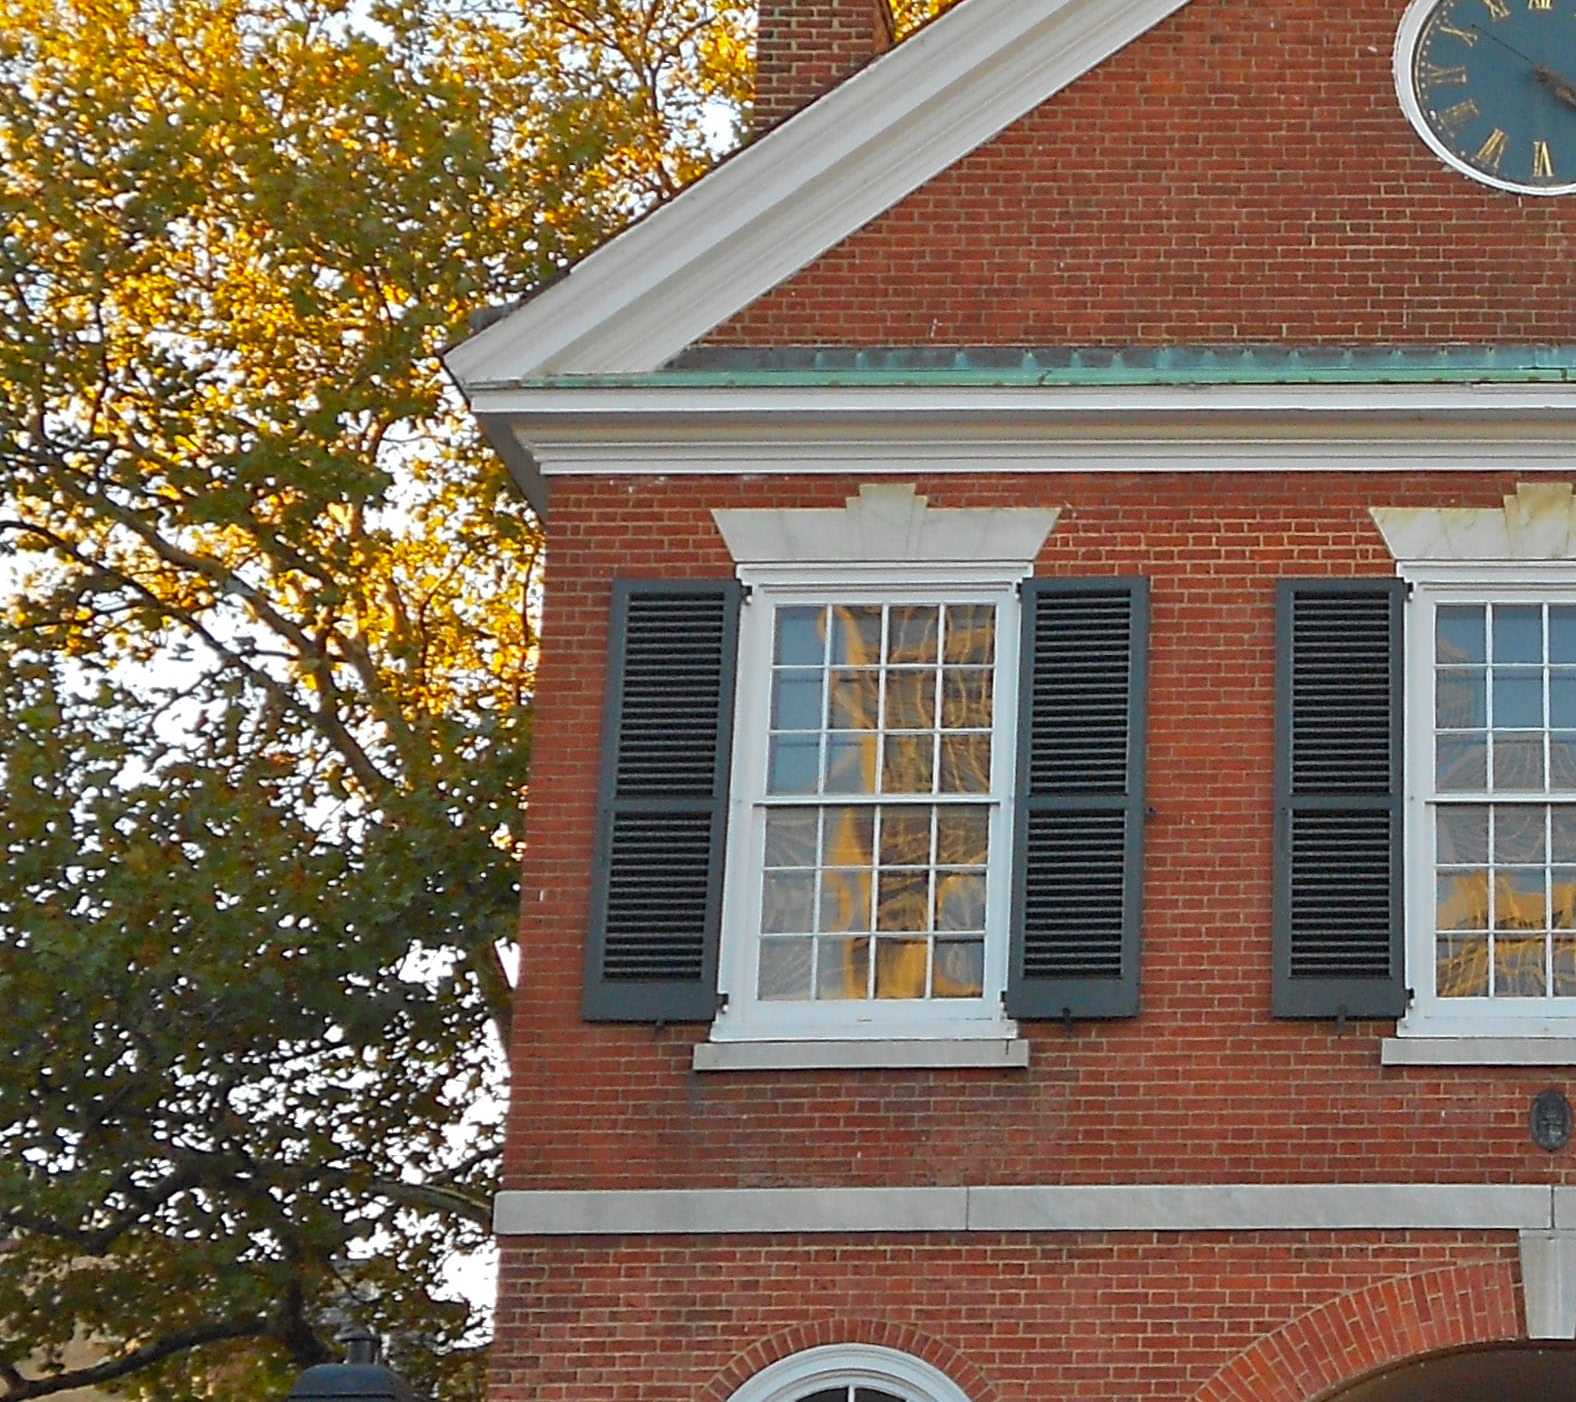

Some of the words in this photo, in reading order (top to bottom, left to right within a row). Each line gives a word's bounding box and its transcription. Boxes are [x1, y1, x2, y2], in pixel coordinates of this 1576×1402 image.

[1440, 24, 1477, 47] X
[1427, 64, 1467, 84] IX
[1475, 128, 1507, 169] VII
[1532, 141, 1553, 177] VI
